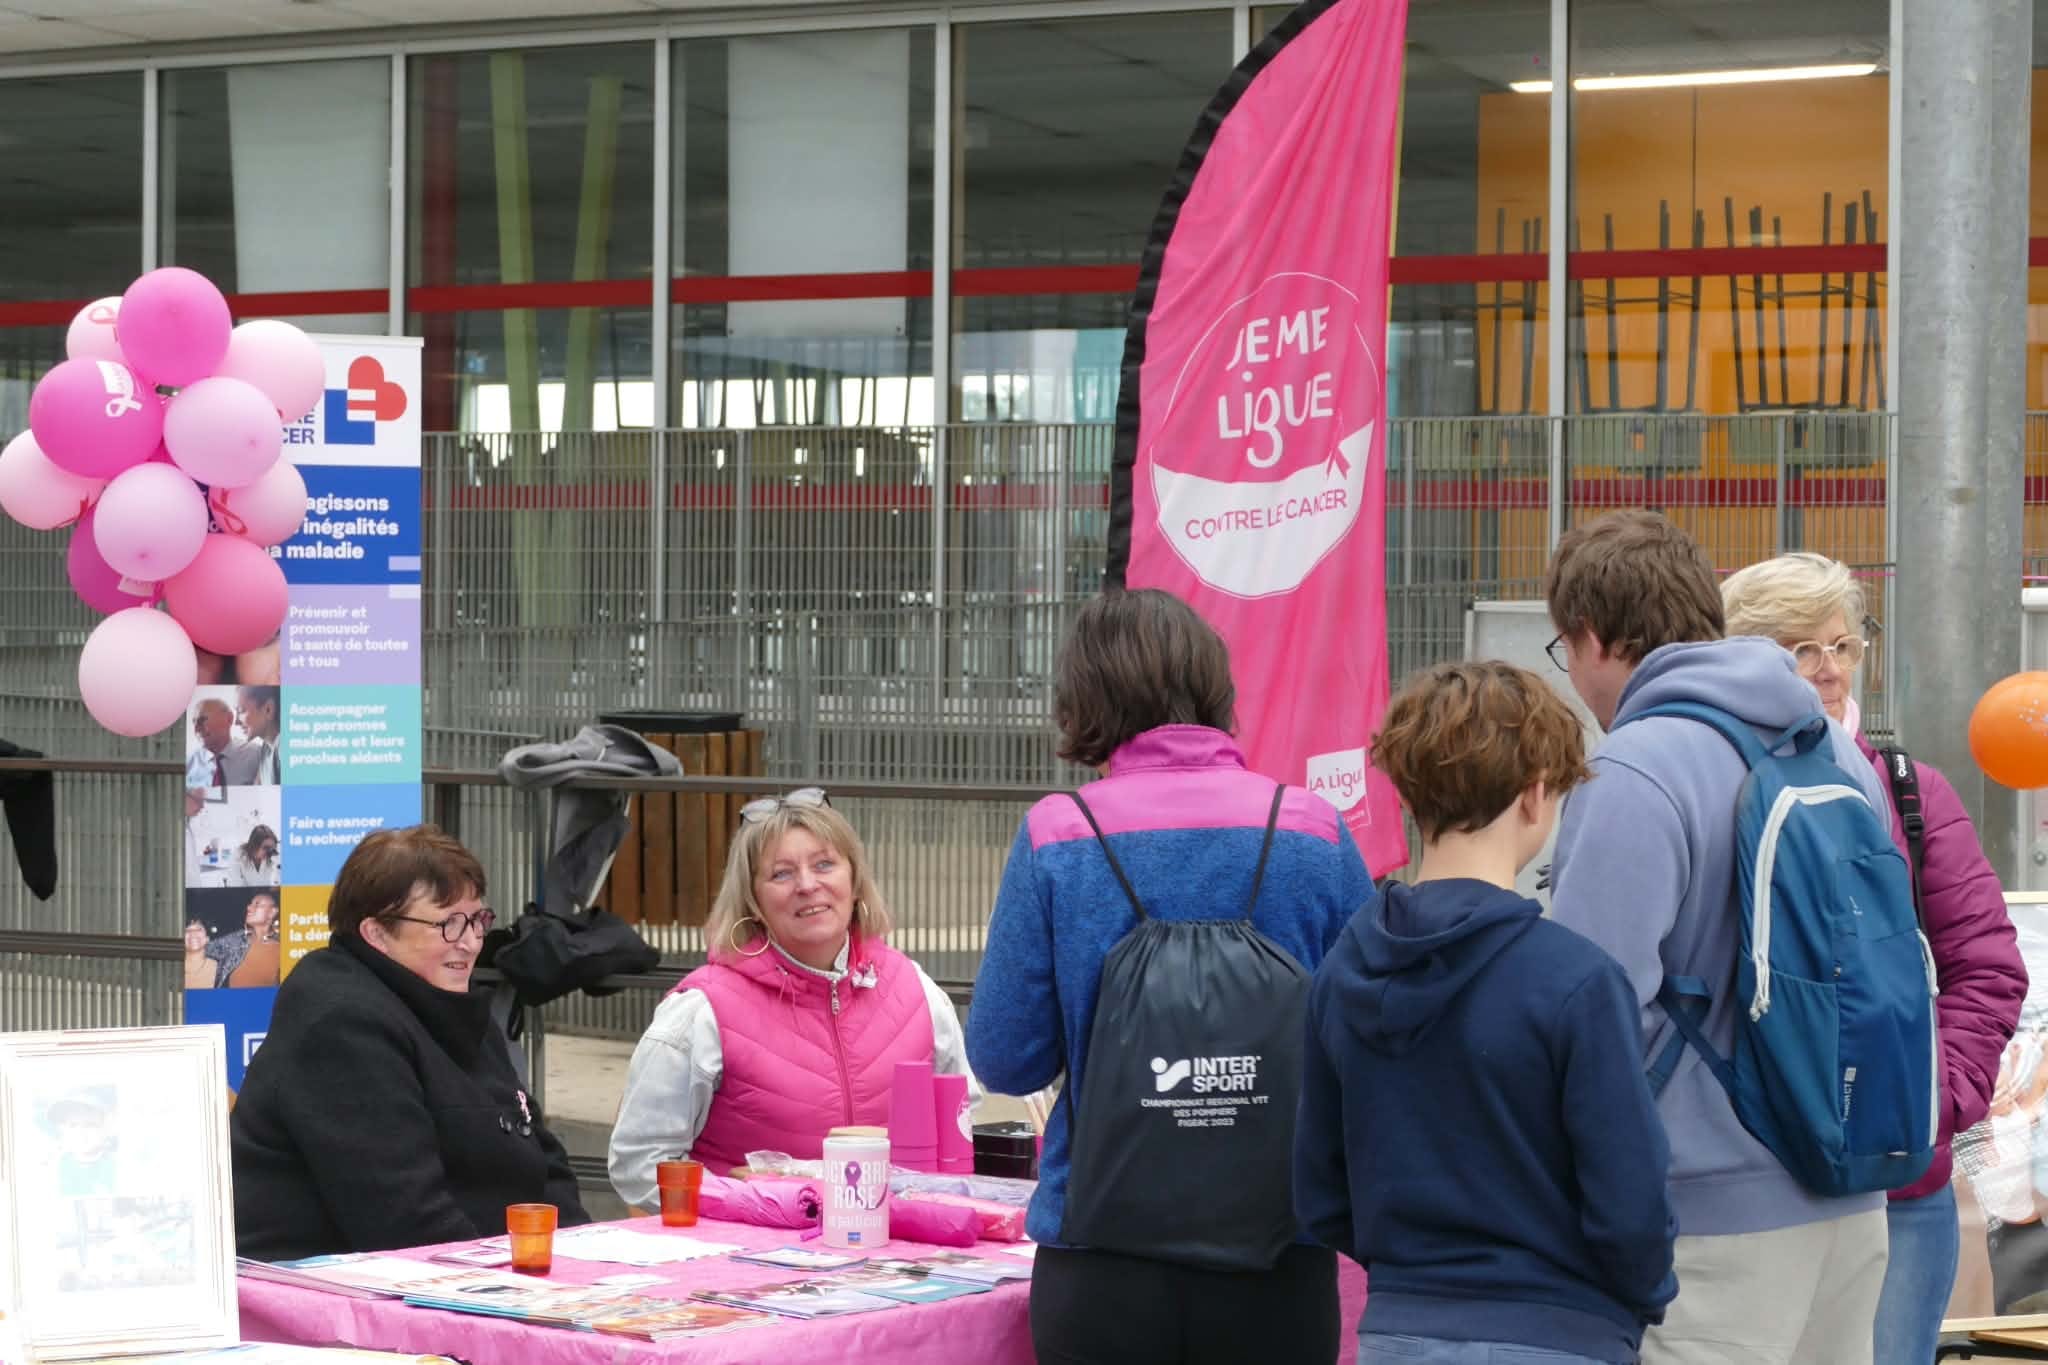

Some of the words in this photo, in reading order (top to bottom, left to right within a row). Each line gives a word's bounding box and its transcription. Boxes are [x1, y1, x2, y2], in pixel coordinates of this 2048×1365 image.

[1225, 317, 1270, 371] JE
[1275, 306, 1330, 358] ME
[306, 493, 390, 516] agissons
[303, 517, 400, 538] inégalités
[286, 541, 365, 559] maladie
[289, 605, 348, 618] Prévenir
[351, 606, 368, 618] et
[289, 622, 369, 636] promouvoir
[364, 639, 409, 651] toutes
[307, 655, 340, 668] tous
[289, 703, 387, 719] Accompagner
[289, 815, 325, 830] Faire
[1193, 1056, 1258, 1076] INTER
[1192, 1074, 1257, 1093] SPORT
[833, 1184, 877, 1209] ROSE
